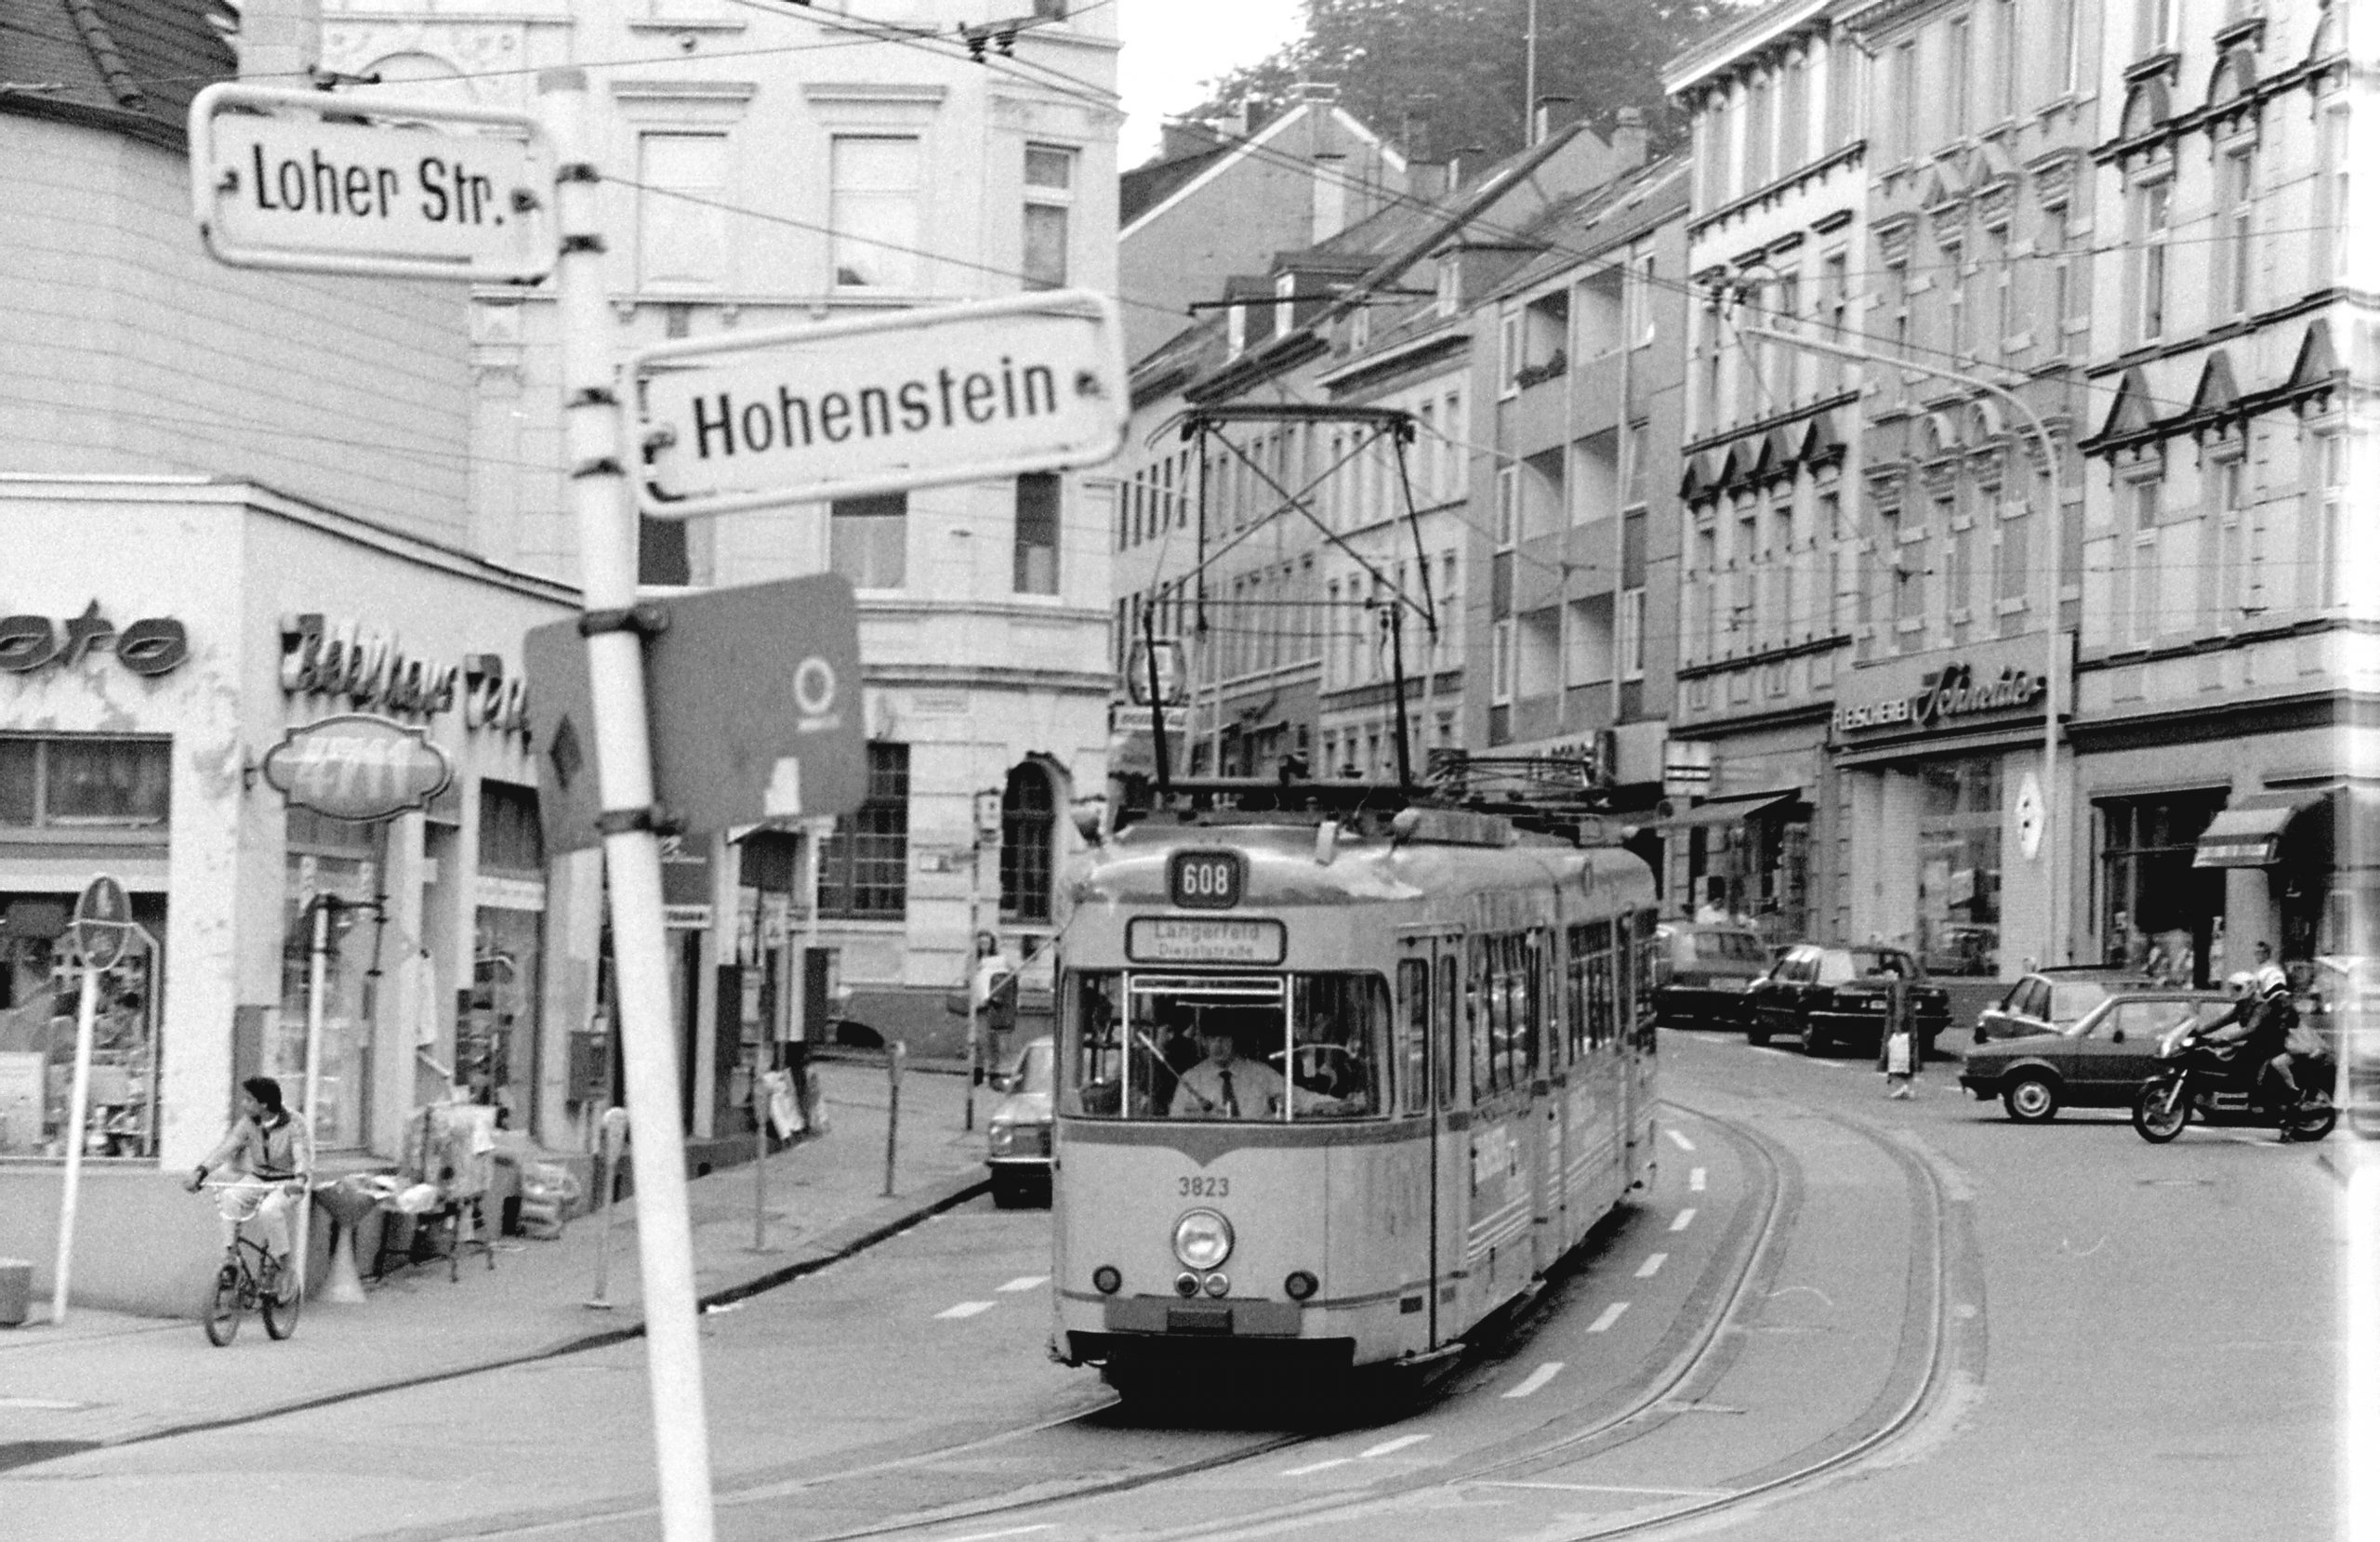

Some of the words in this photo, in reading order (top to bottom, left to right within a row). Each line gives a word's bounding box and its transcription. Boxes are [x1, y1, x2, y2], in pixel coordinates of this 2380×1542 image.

[252, 142, 400, 219] Loher
[418, 155, 505, 226] Str.
[692, 355, 1057, 459] Hohenstein
[1183, 863, 1229, 895] 608
[1178, 1176, 1230, 1197] 3823
